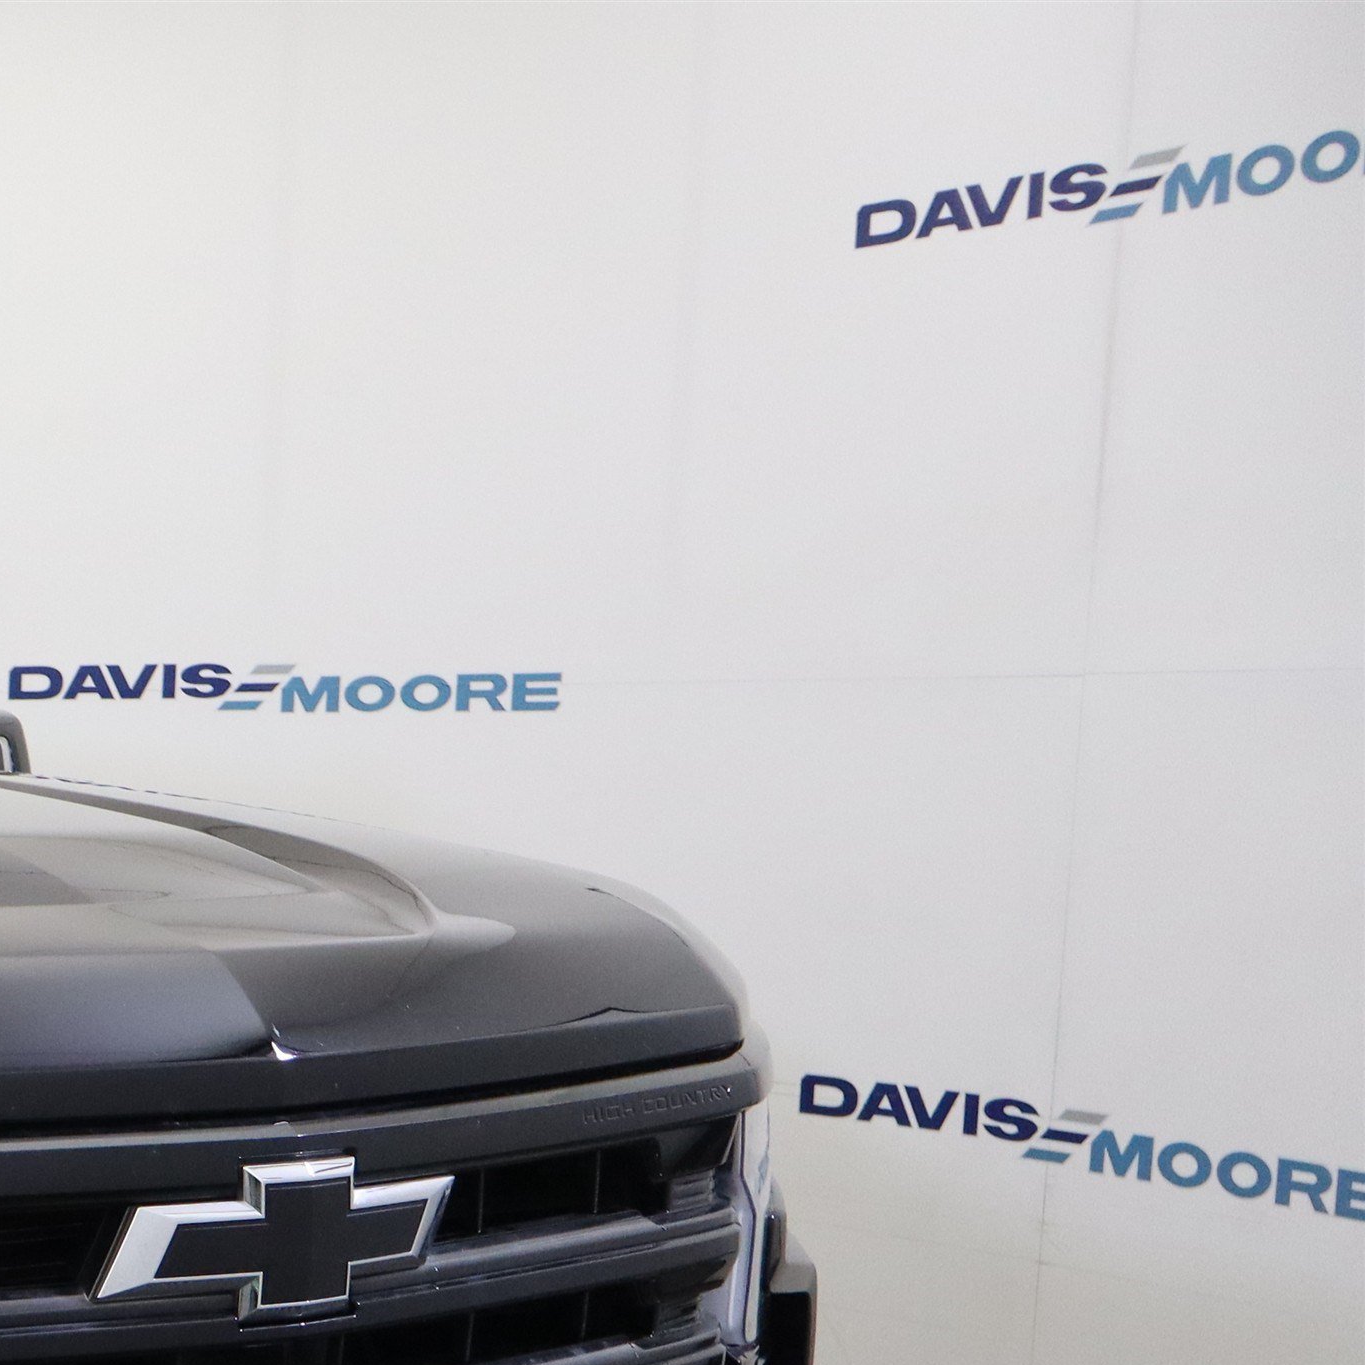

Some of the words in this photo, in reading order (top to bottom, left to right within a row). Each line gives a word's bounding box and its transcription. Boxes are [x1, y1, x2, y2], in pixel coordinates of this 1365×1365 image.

[855, 160, 1106, 248] DAVIS
[1161, 130, 1365, 214] MOO
[7, 662, 230, 700] DAVIS
[279, 672, 562, 713] MOORE
[582, 1104, 636, 1126] HIGH
[642, 1083, 733, 1115] COUNTRY
[799, 1073, 1038, 1140] DAVIS
